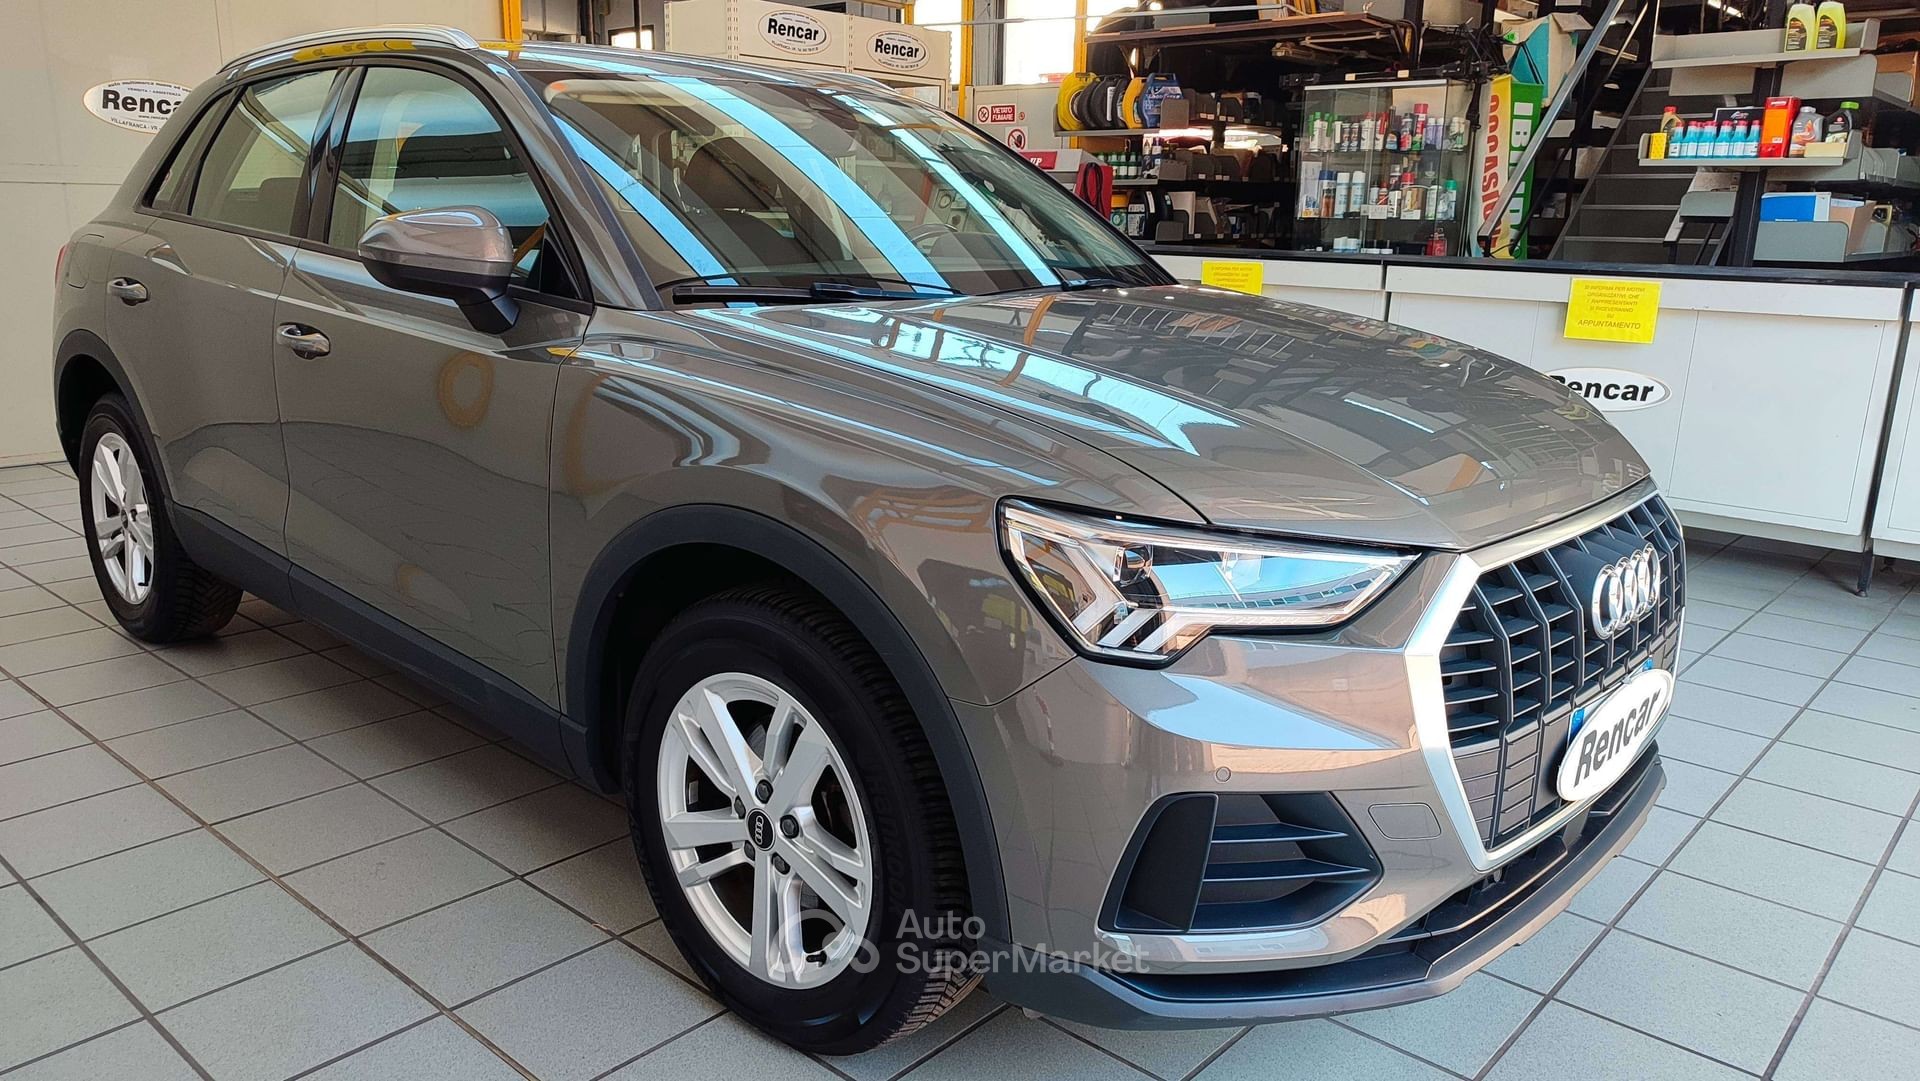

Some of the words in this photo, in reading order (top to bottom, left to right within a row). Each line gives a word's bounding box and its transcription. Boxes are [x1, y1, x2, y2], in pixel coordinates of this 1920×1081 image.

[767, 18, 819, 41] Rencar
[874, 38, 919, 58] Rencar
[102, 89, 182, 114] Renca
[992, 106, 1013, 114] VIETATO
[992, 113, 1014, 121] FUMARE
[111, 117, 147, 129] VILLAFRANCA
[1577, 319, 1641, 330] APPUNTAMENTO
[1573, 687, 1662, 788] Rencar
